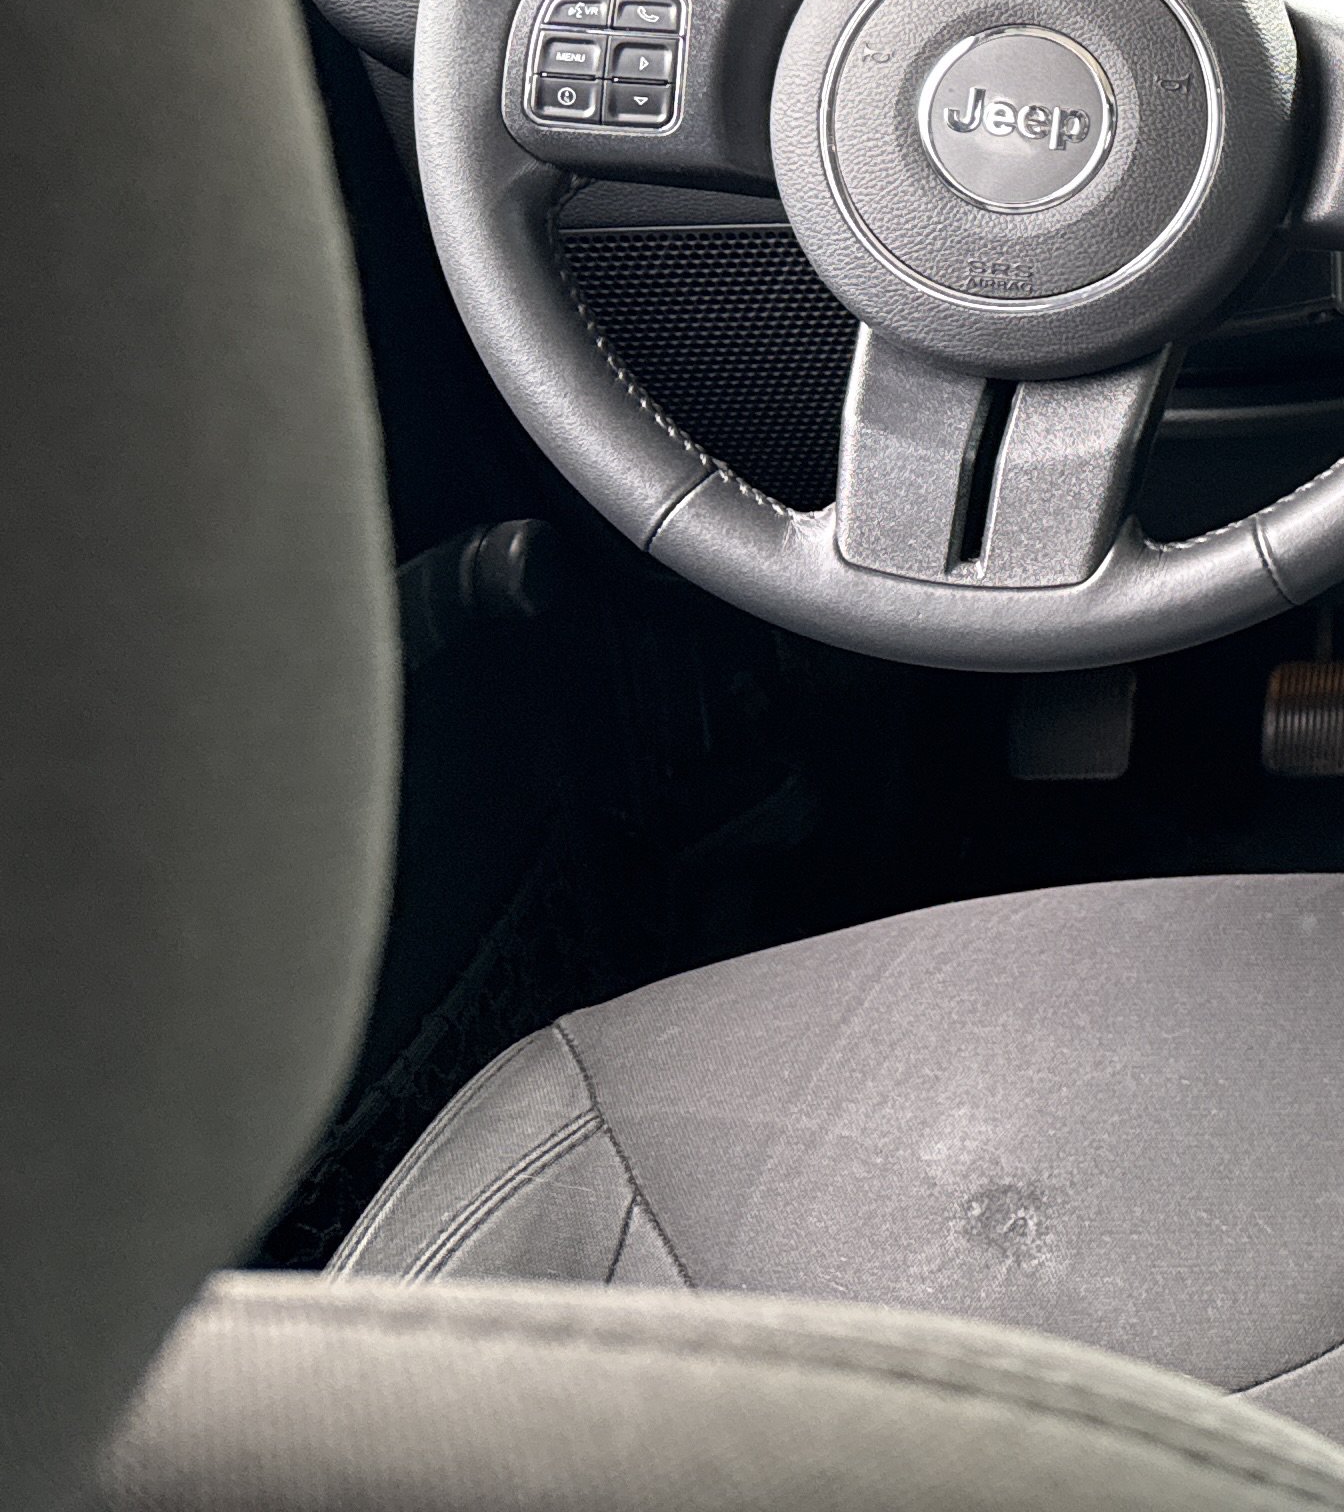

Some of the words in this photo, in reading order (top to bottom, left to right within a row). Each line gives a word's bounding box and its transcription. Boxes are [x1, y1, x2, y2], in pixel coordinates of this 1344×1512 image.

[584, 6, 599, 16] VR
[555, 52, 586, 63] MENU
[943, 87, 1091, 151] Jeep
